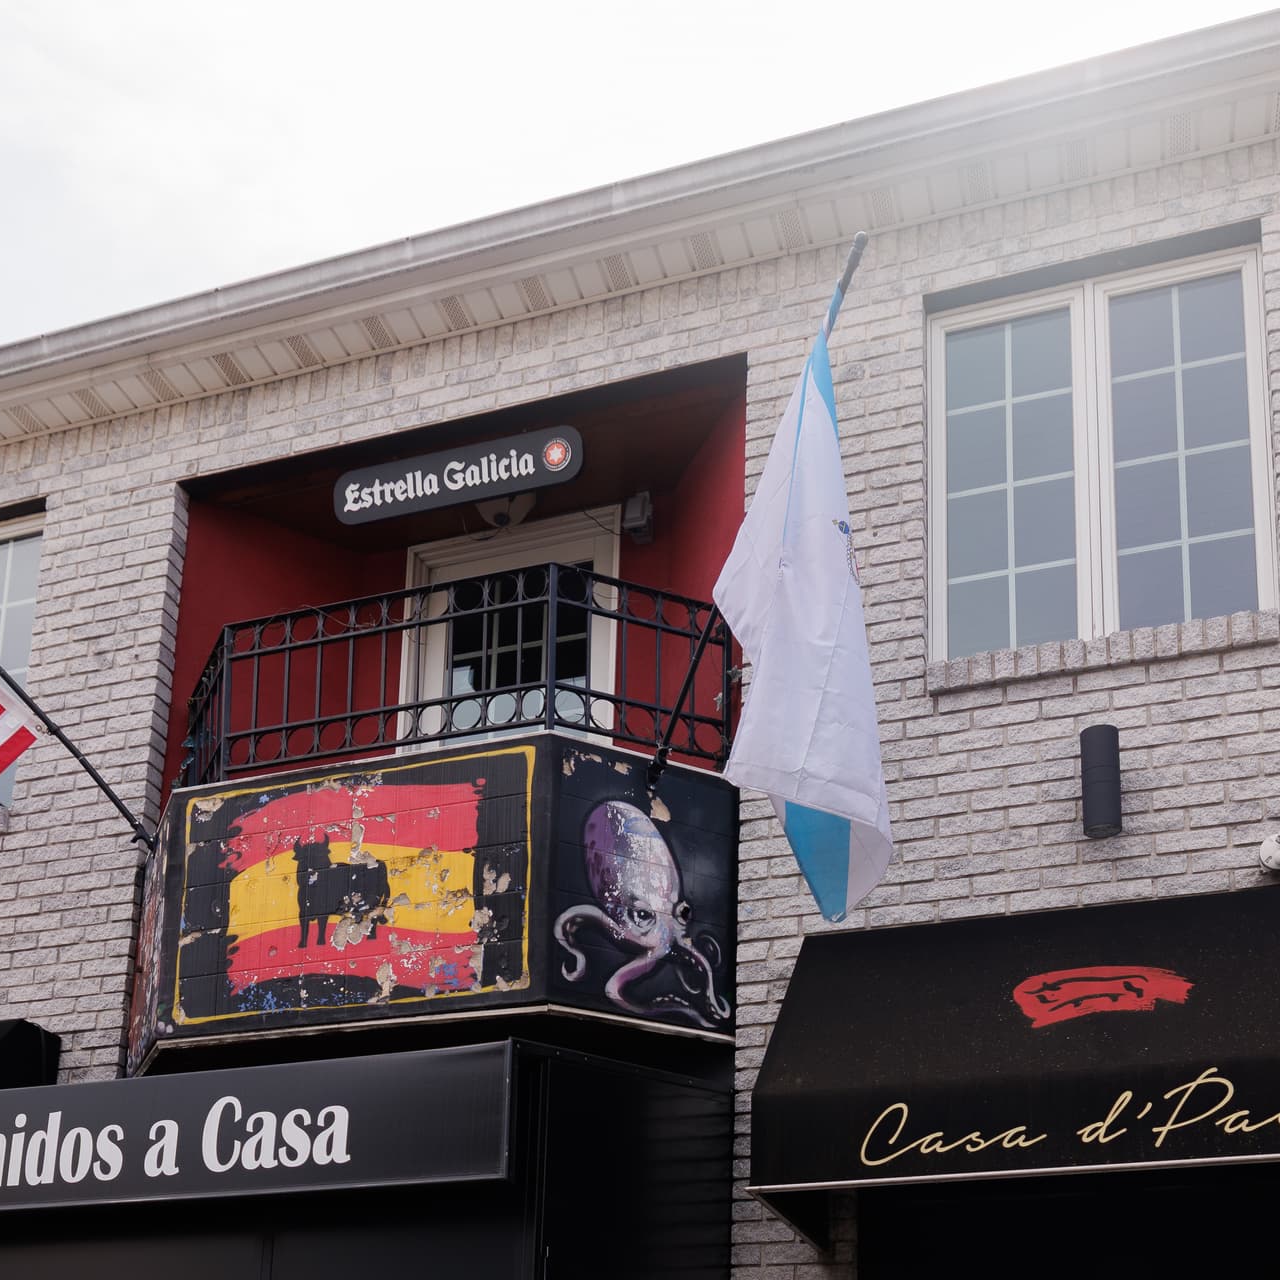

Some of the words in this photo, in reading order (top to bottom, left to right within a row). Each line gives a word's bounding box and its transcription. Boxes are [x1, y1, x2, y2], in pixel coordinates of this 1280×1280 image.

[344, 470, 440, 513] Estrella
[443, 448, 536, 491] Galicia
[144, 1118, 180, 1178] a
[201, 1095, 352, 1173] Casa
[860, 1102, 1048, 1167] Casa
